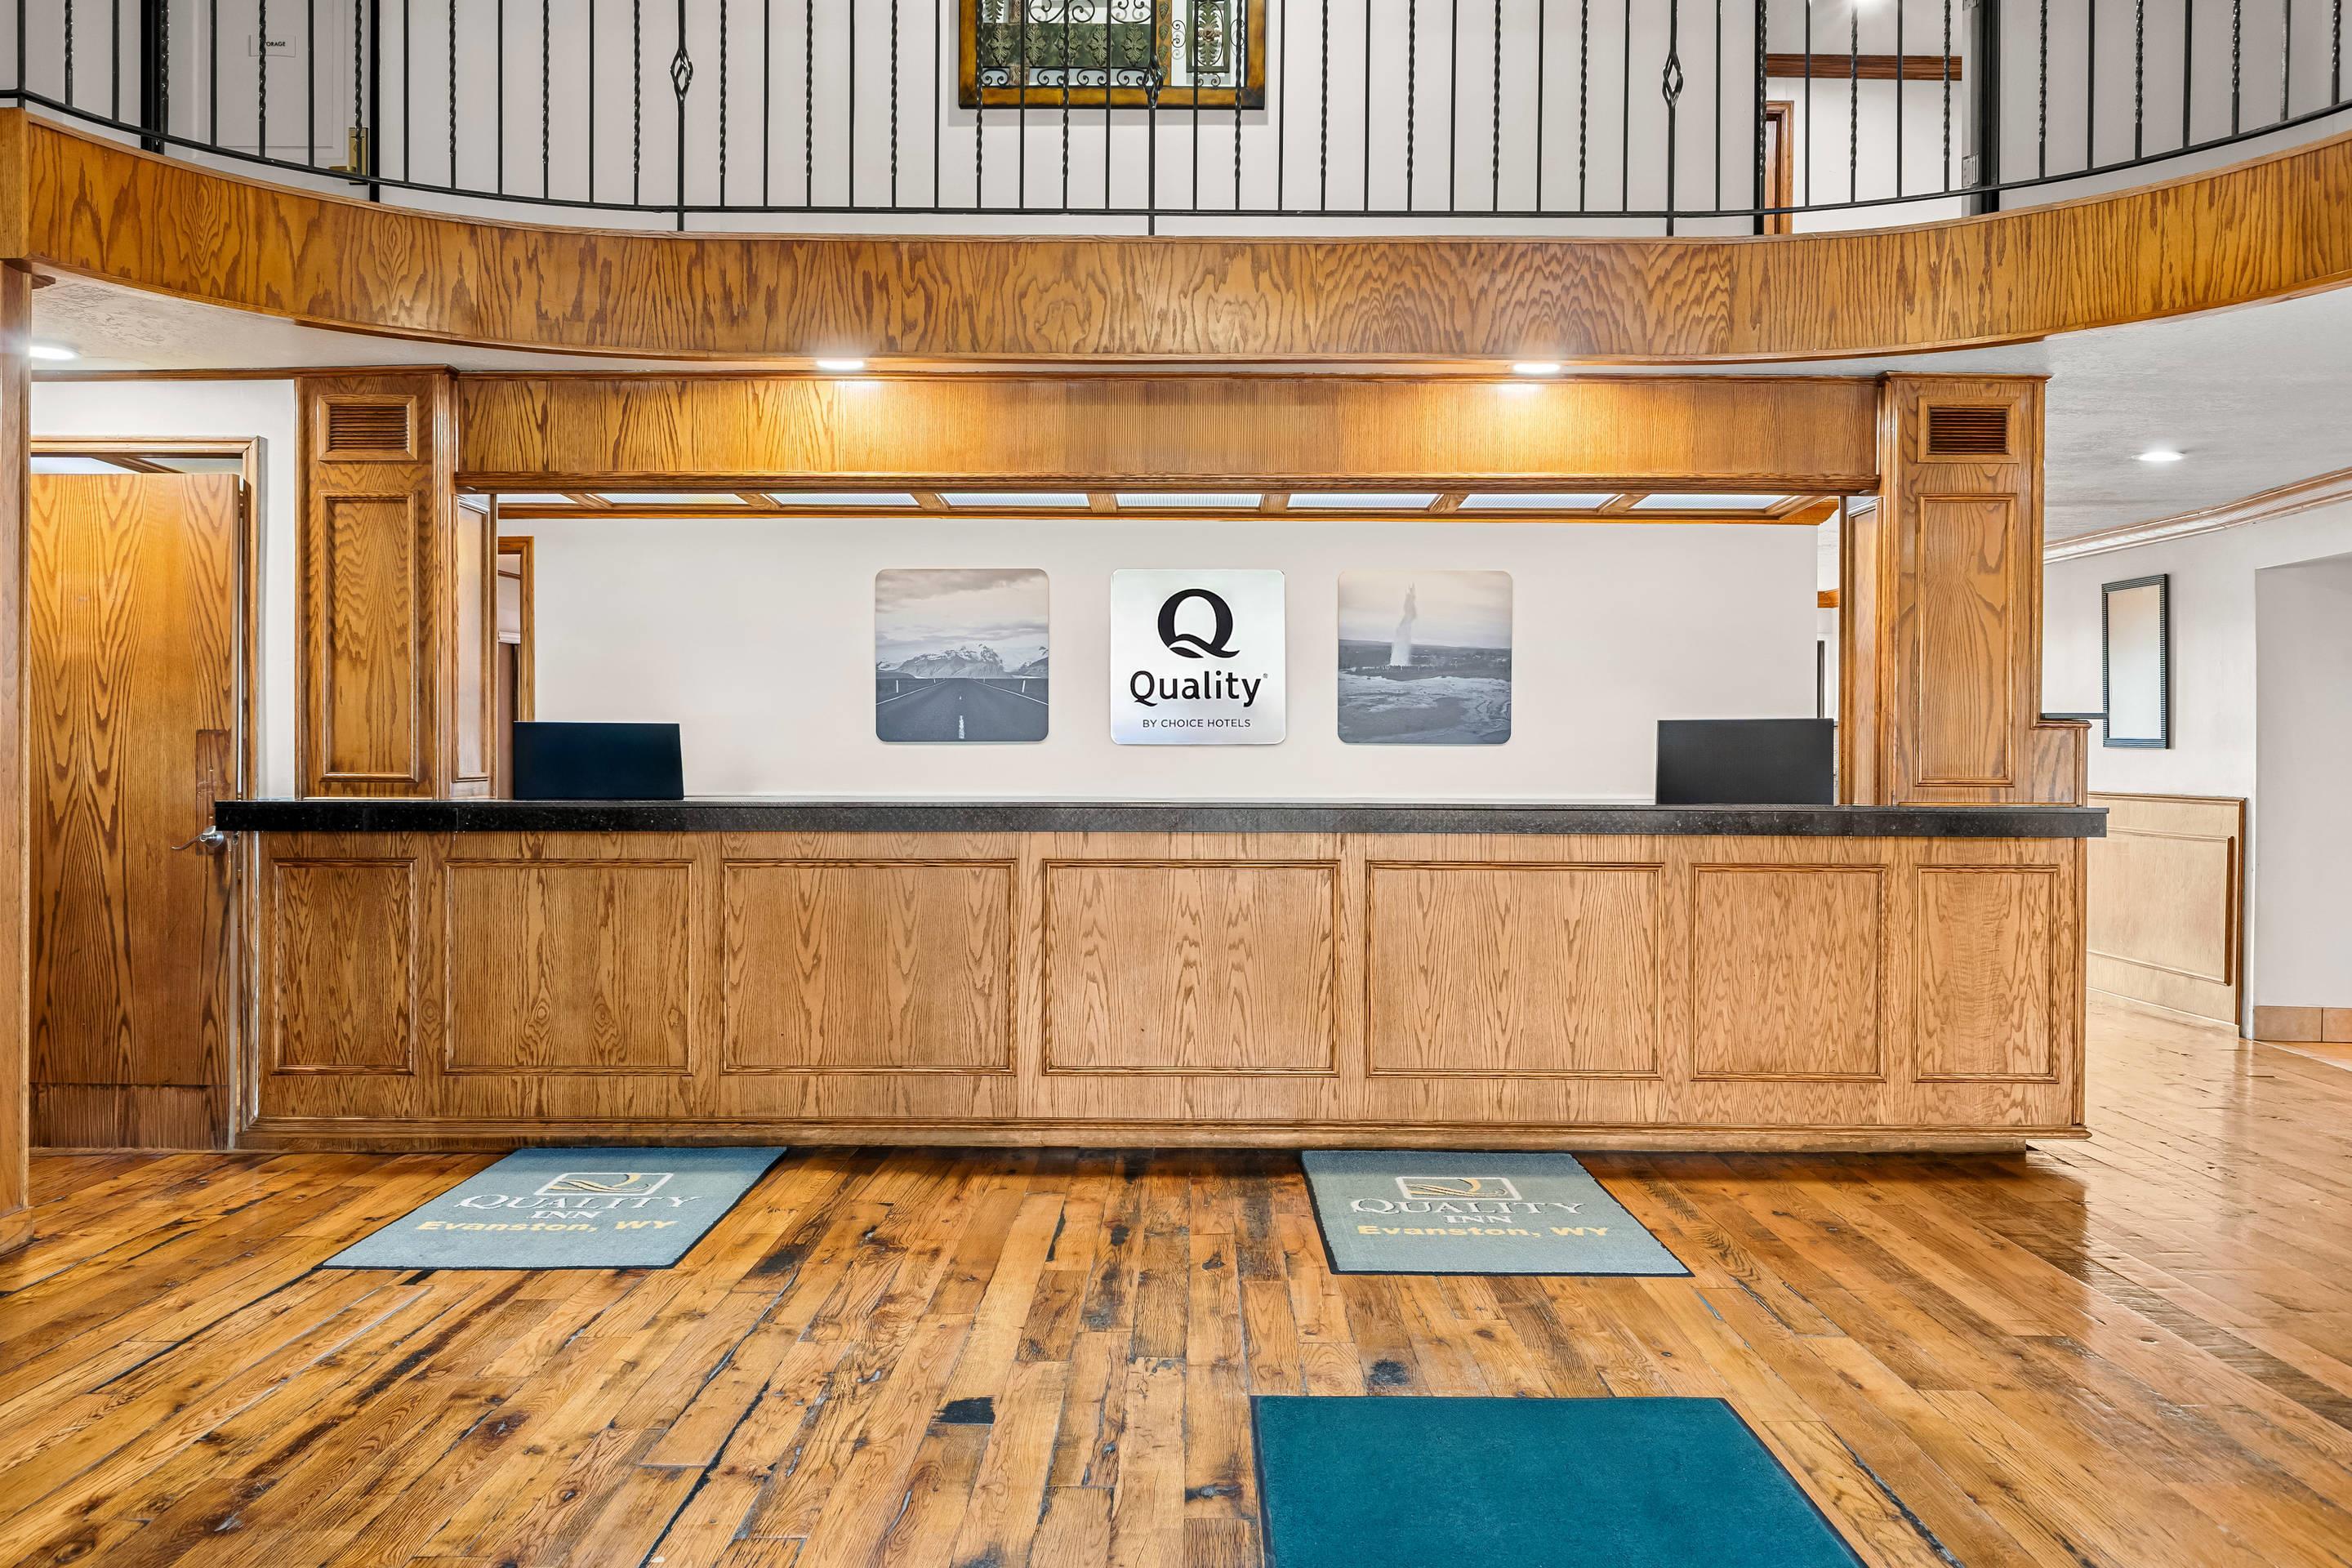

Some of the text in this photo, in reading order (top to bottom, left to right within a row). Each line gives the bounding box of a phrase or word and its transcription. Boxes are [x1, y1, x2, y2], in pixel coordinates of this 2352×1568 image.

[1130, 670, 1262, 707] Quality
[1143, 719, 1251, 728] BY CHOICE HOTELS
[453, 1194, 704, 1209] QUALITY
[1350, 1198, 1586, 1214] QUALITY
[526, 1210, 604, 1219] INN
[1443, 1215, 1512, 1223] INN
[415, 1220, 679, 1232] Evanston, WY
[1356, 1225, 1608, 1238] Evanston, WY
